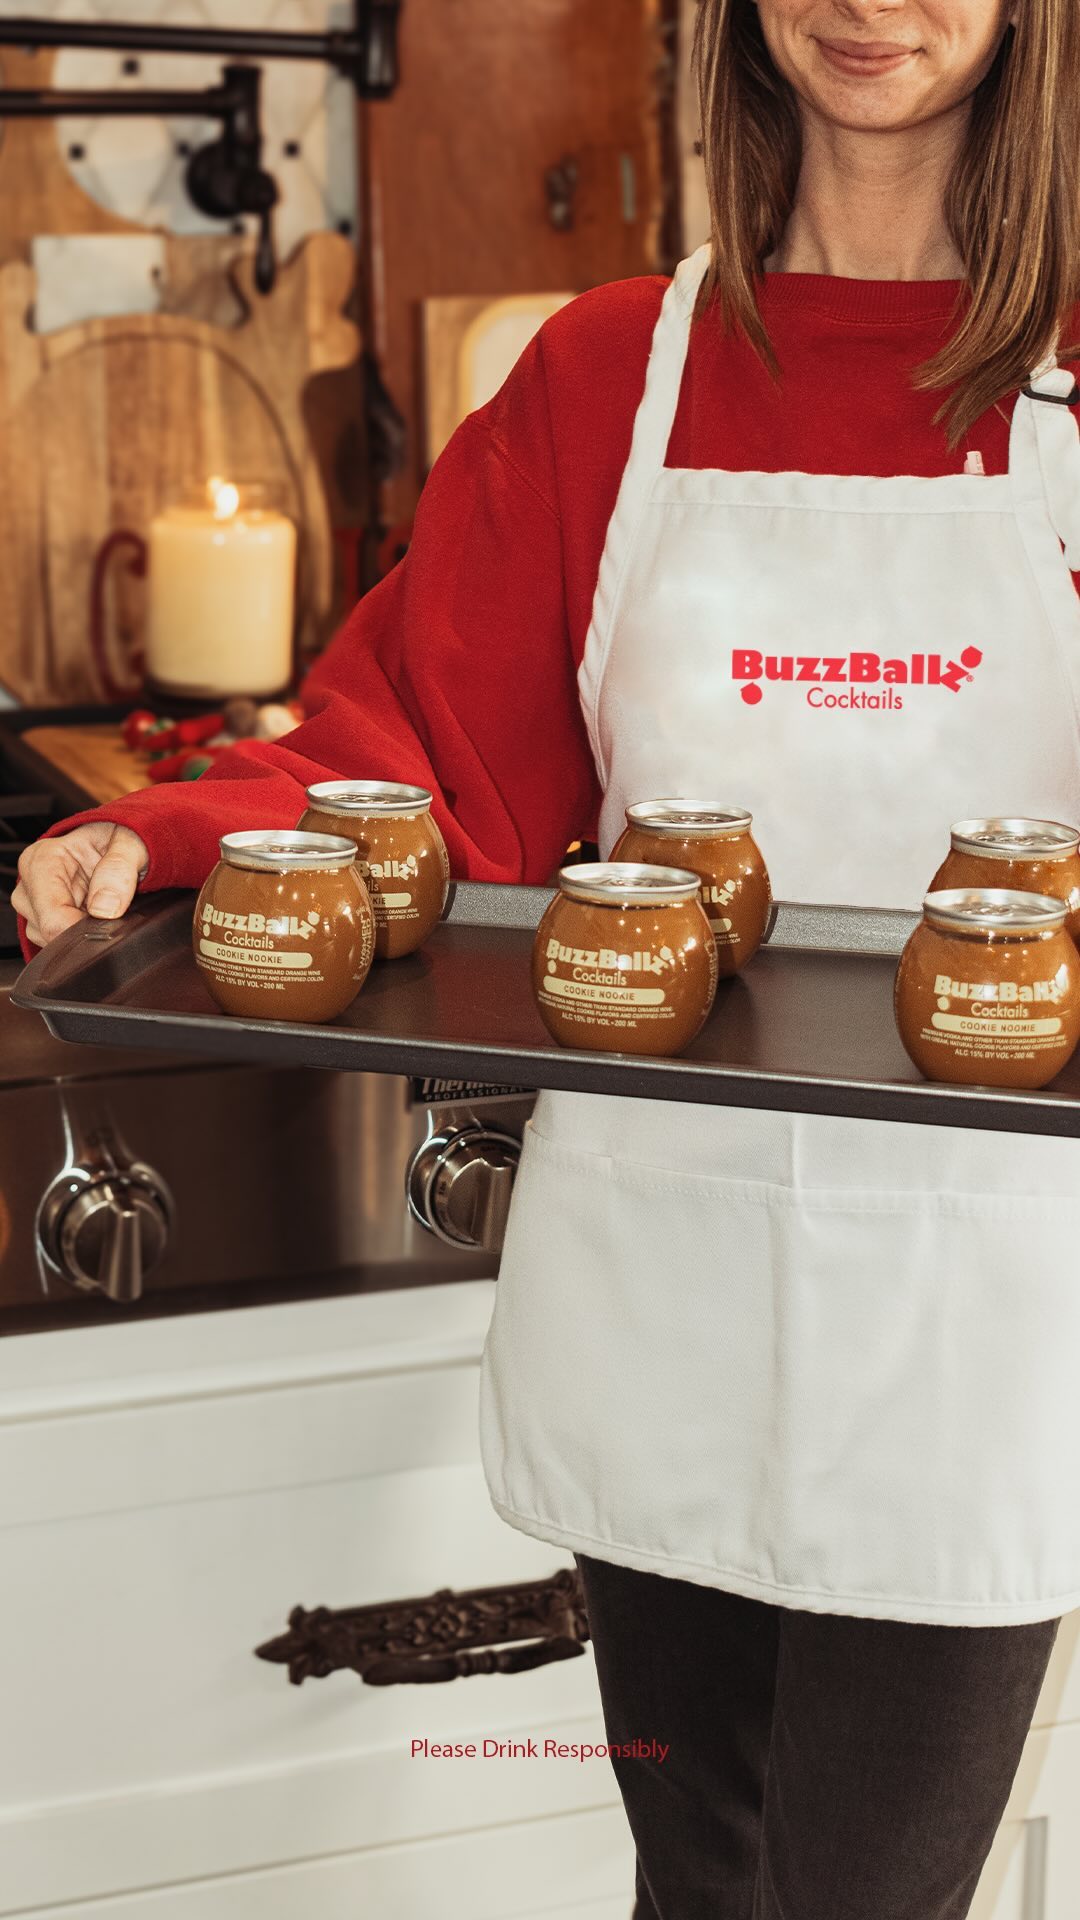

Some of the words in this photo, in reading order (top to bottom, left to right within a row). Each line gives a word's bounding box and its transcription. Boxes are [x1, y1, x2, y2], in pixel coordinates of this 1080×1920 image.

[732, 648, 970, 694] BuzzBallz
[806, 686, 903, 710] Cocktails
[354, 860, 414, 881] Ballz
[202, 902, 314, 941] BuzzBallz
[224, 930, 275, 949] Cocktails
[216, 948, 245, 960] COOKIE
[248, 953, 283, 964] NOOKIE
[546, 938, 668, 976] BuzzBallz
[257, 968, 285, 976] STANDARD
[572, 967, 627, 986] Cocktails
[247, 980, 260, 988] VOL
[563, 984, 596, 997] COOKIE
[599, 989, 635, 1001] NOOKIE
[971, 1002, 1029, 1018] Cocktails
[597, 1018, 610, 1026] VOL
[627, 1020, 637, 1028] ML
[960, 1021, 997, 1032] COOKIE
[954, 1048, 968, 1056] ALC
[984, 1051, 995, 1059] BY
[422, 1077, 497, 1095] Therm
